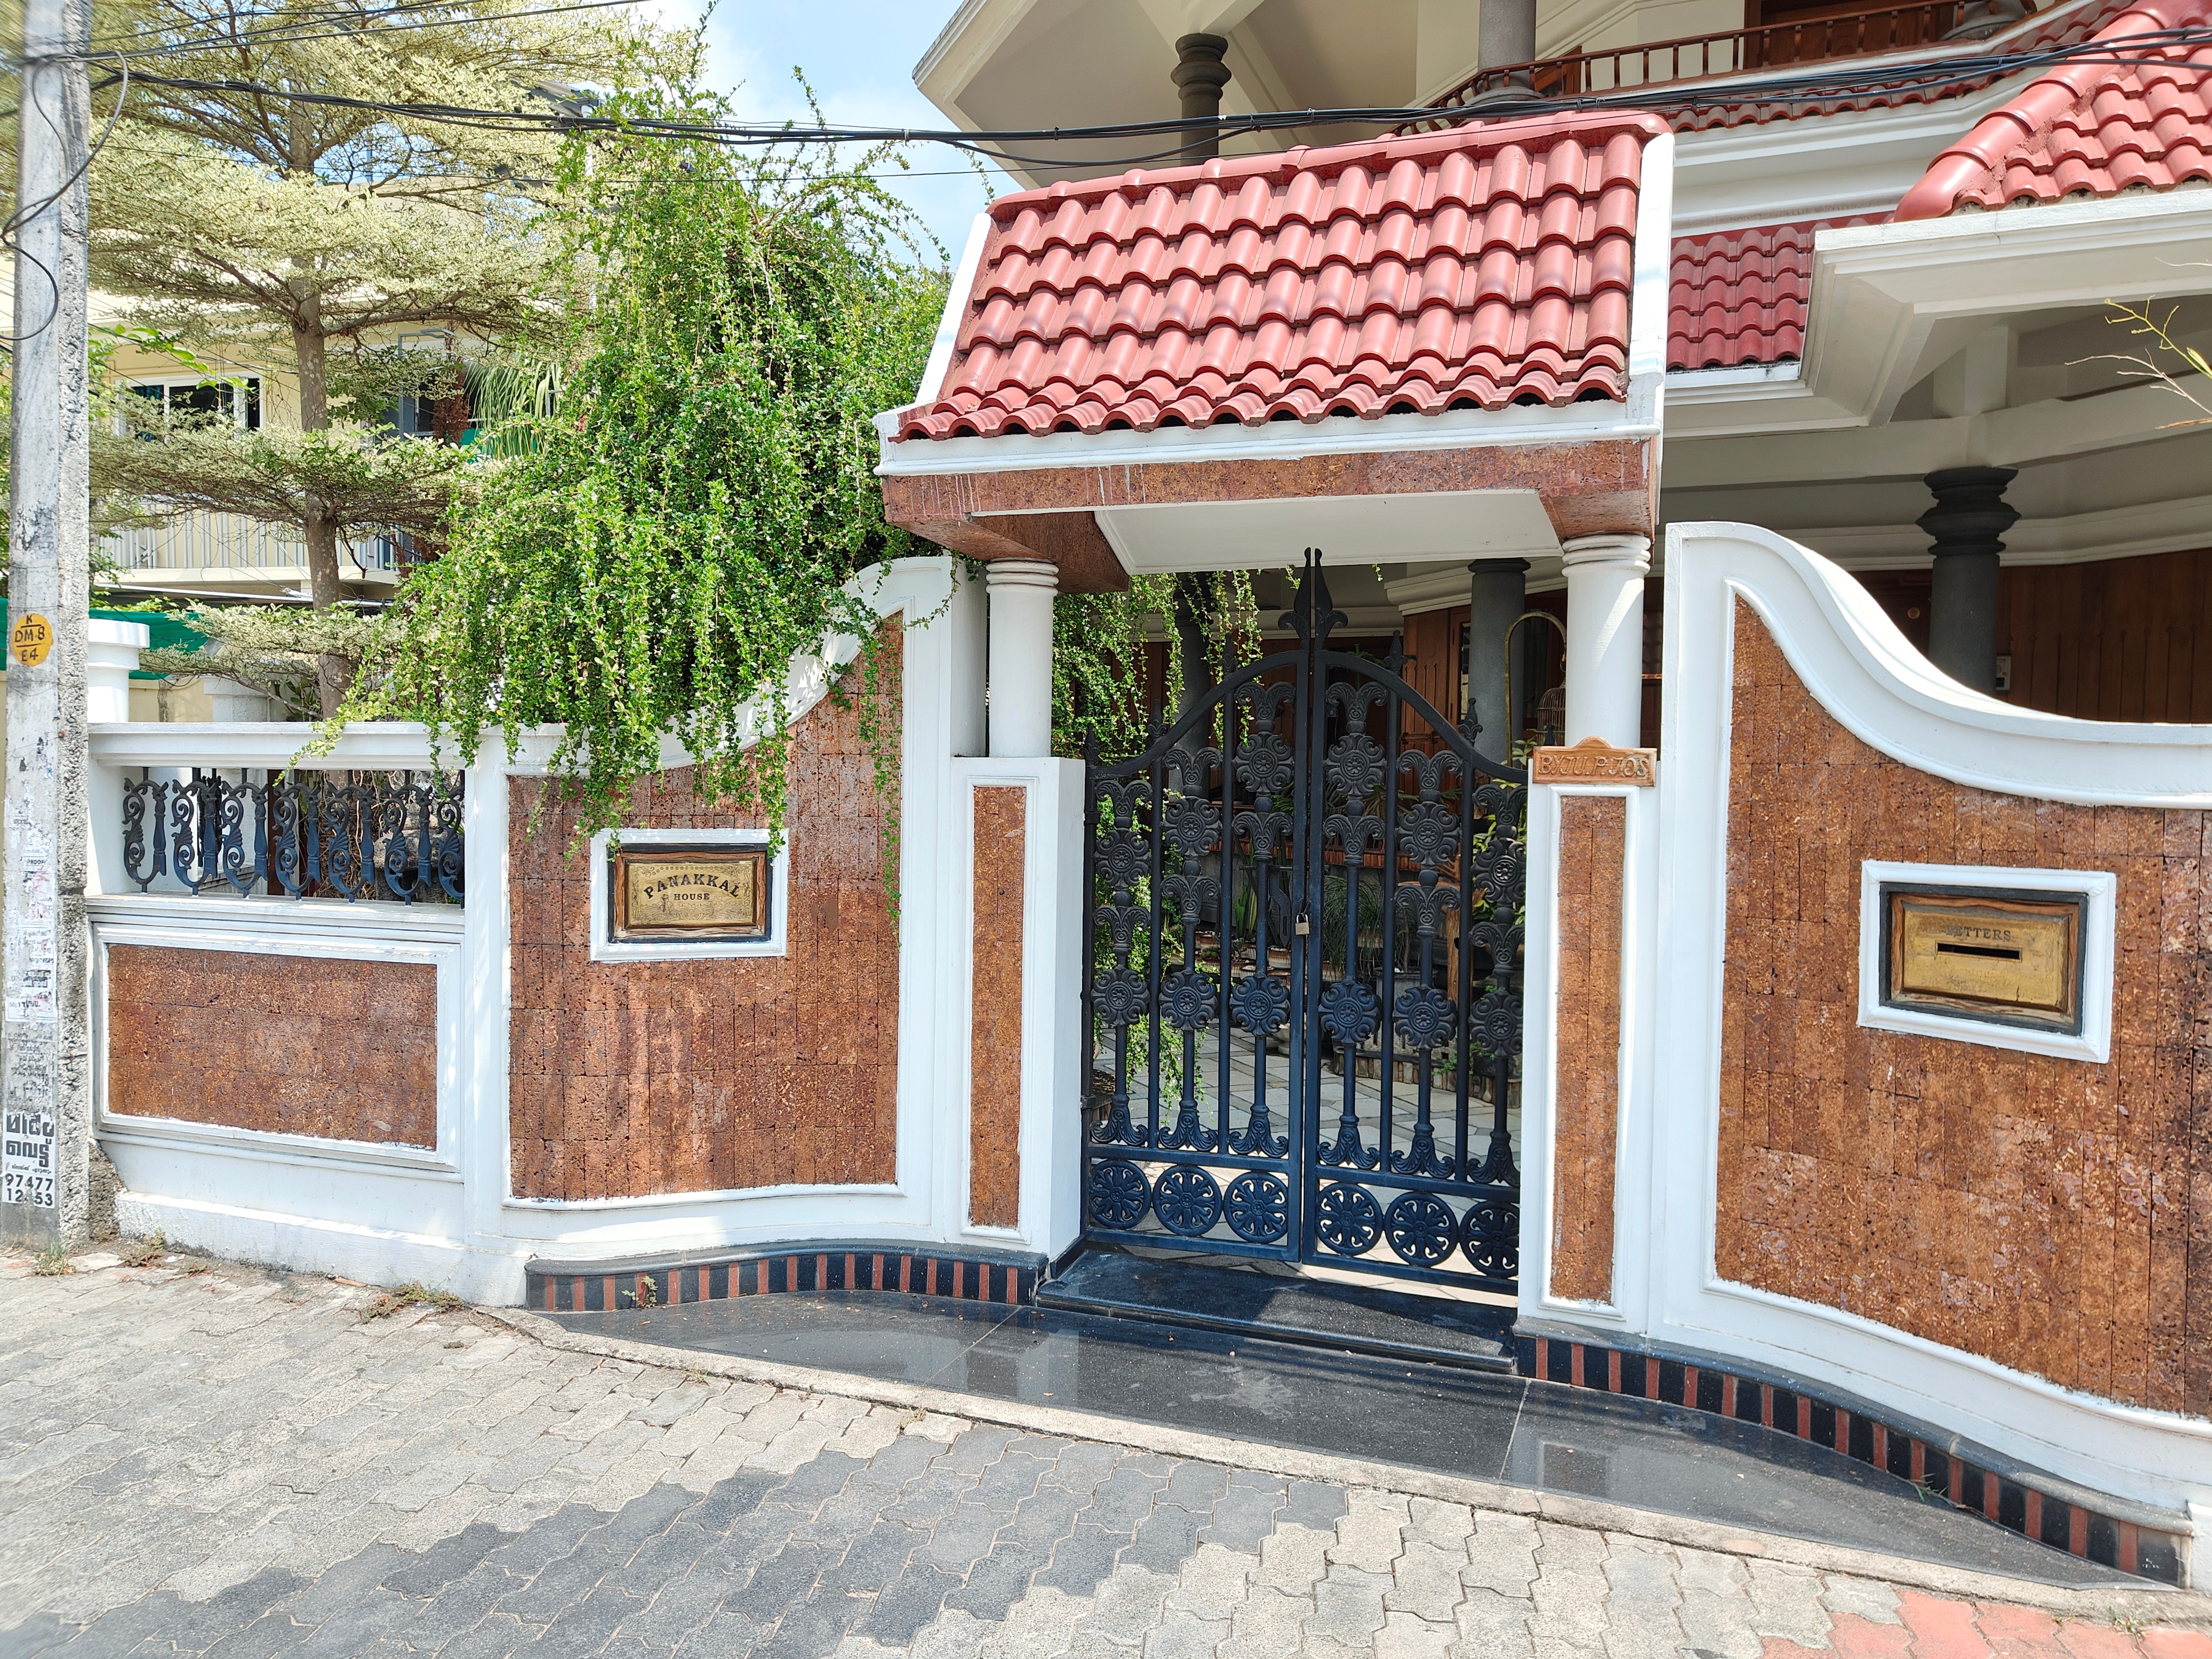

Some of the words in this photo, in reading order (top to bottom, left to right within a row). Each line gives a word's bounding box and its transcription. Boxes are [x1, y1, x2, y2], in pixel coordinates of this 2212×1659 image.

[26, 615, 33, 624] K
[21, 648, 39, 662] E4
[644, 874, 739, 899] PANAKKAL
[1946, 925, 2011, 942] LETTERS
[5, 1173, 53, 1191] 97477
[7, 1188, 53, 1206] 1253
